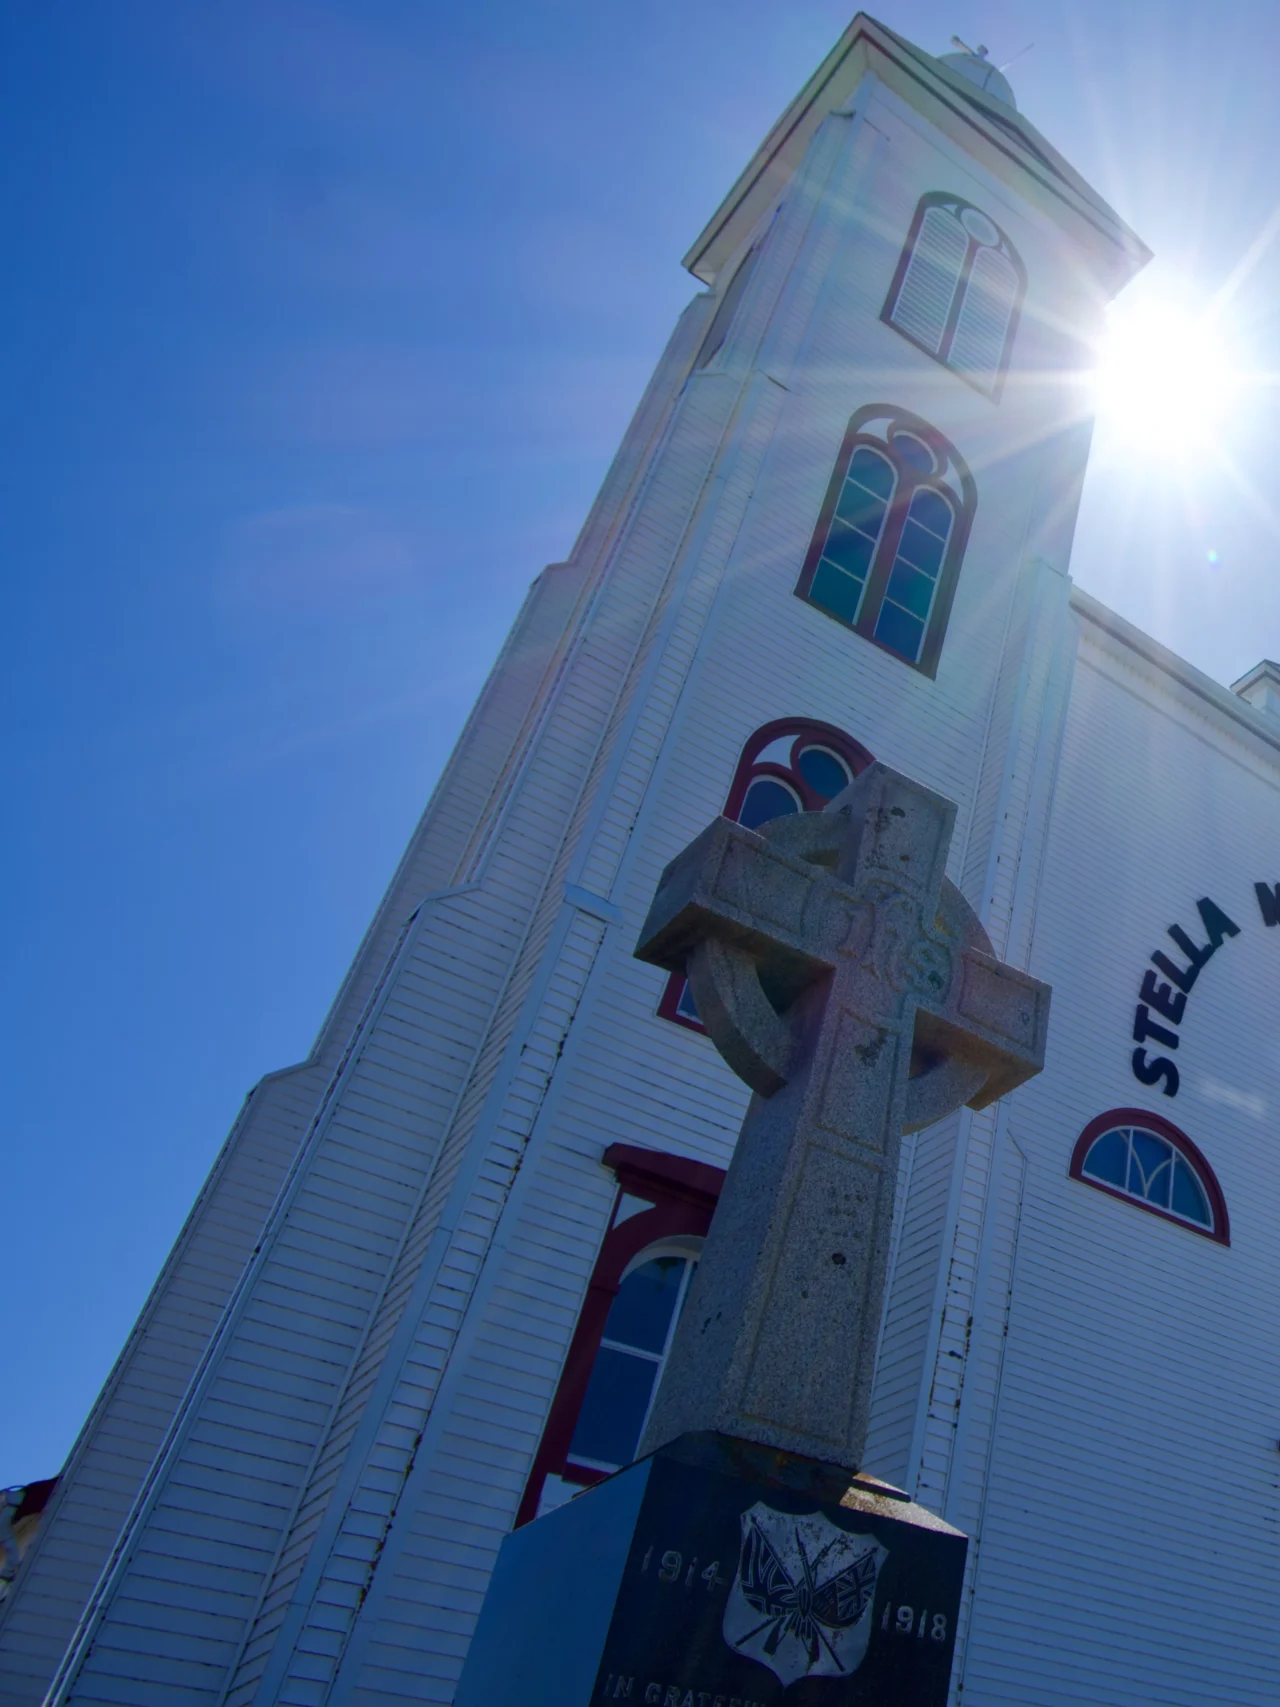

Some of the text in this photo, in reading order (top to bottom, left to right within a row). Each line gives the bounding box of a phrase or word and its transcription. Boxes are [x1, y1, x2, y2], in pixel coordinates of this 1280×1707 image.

[1132, 897, 1241, 1097] STELLA
[641, 1545, 727, 1592] 1914
[881, 1601, 947, 1642] 1918
[603, 1673, 636, 1698] IN
